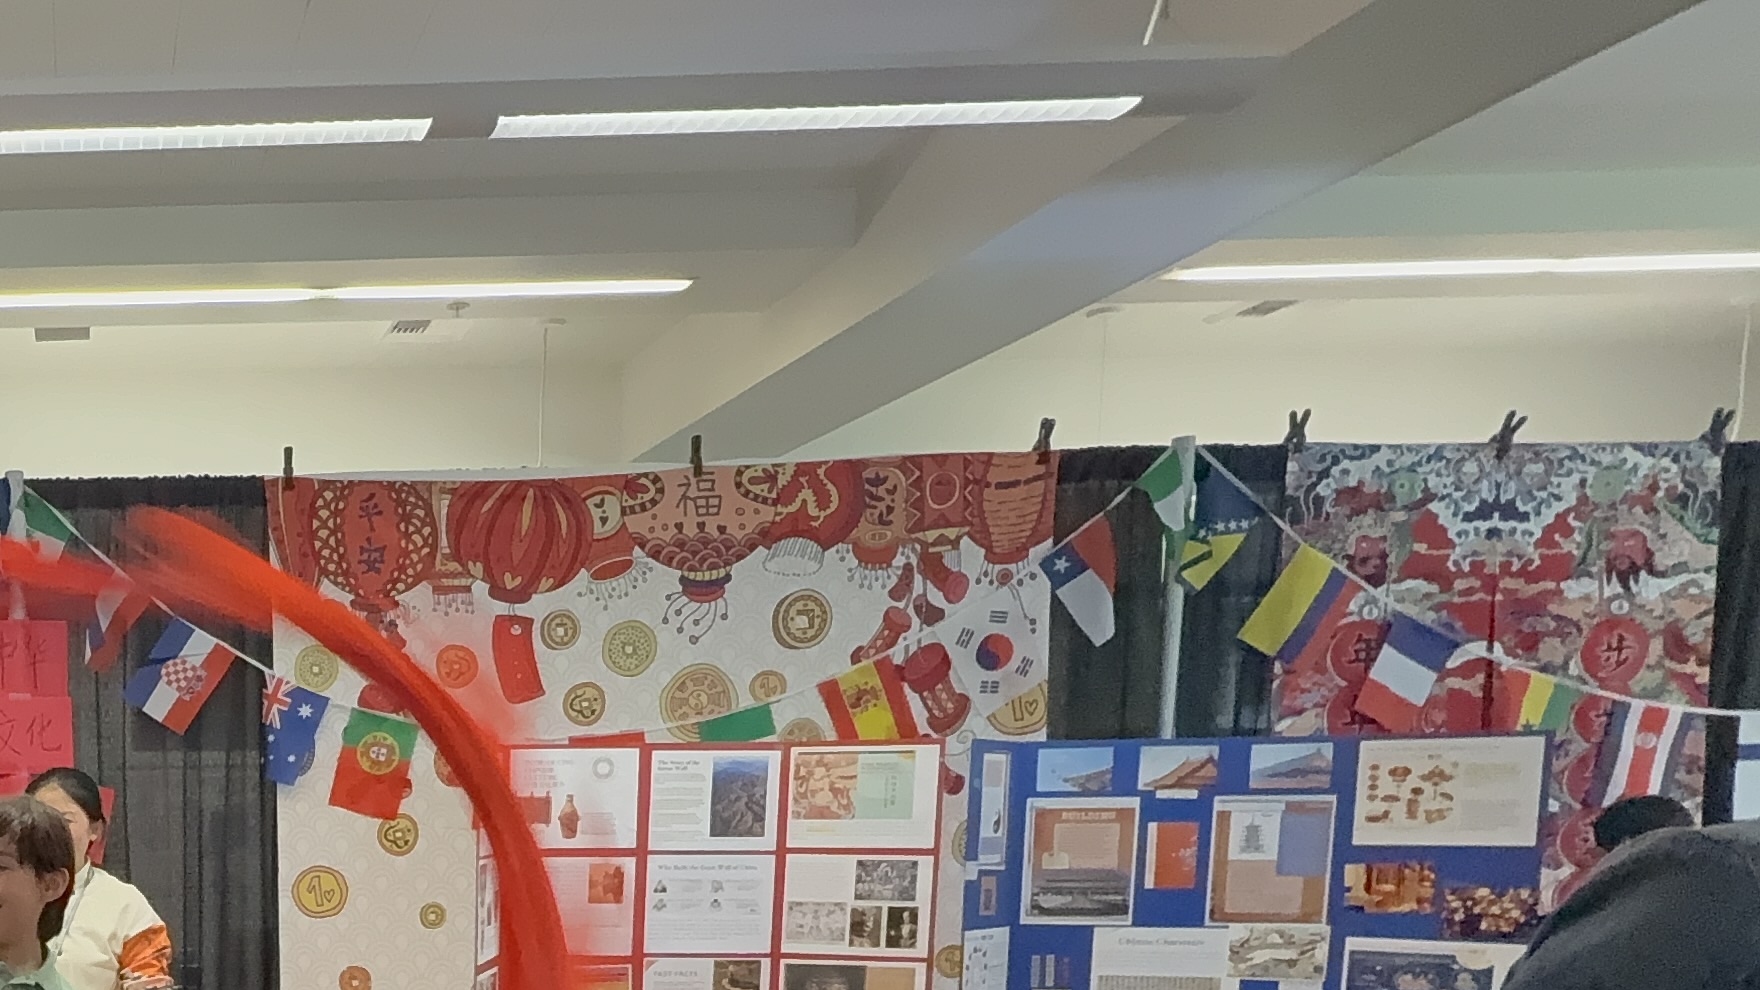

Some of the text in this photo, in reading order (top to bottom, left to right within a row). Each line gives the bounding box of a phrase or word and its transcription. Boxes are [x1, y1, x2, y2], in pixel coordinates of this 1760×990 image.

[676, 470, 722, 517] 福
[358, 492, 389, 575] 平安
[653, 970, 698, 978] FAST FACTS
